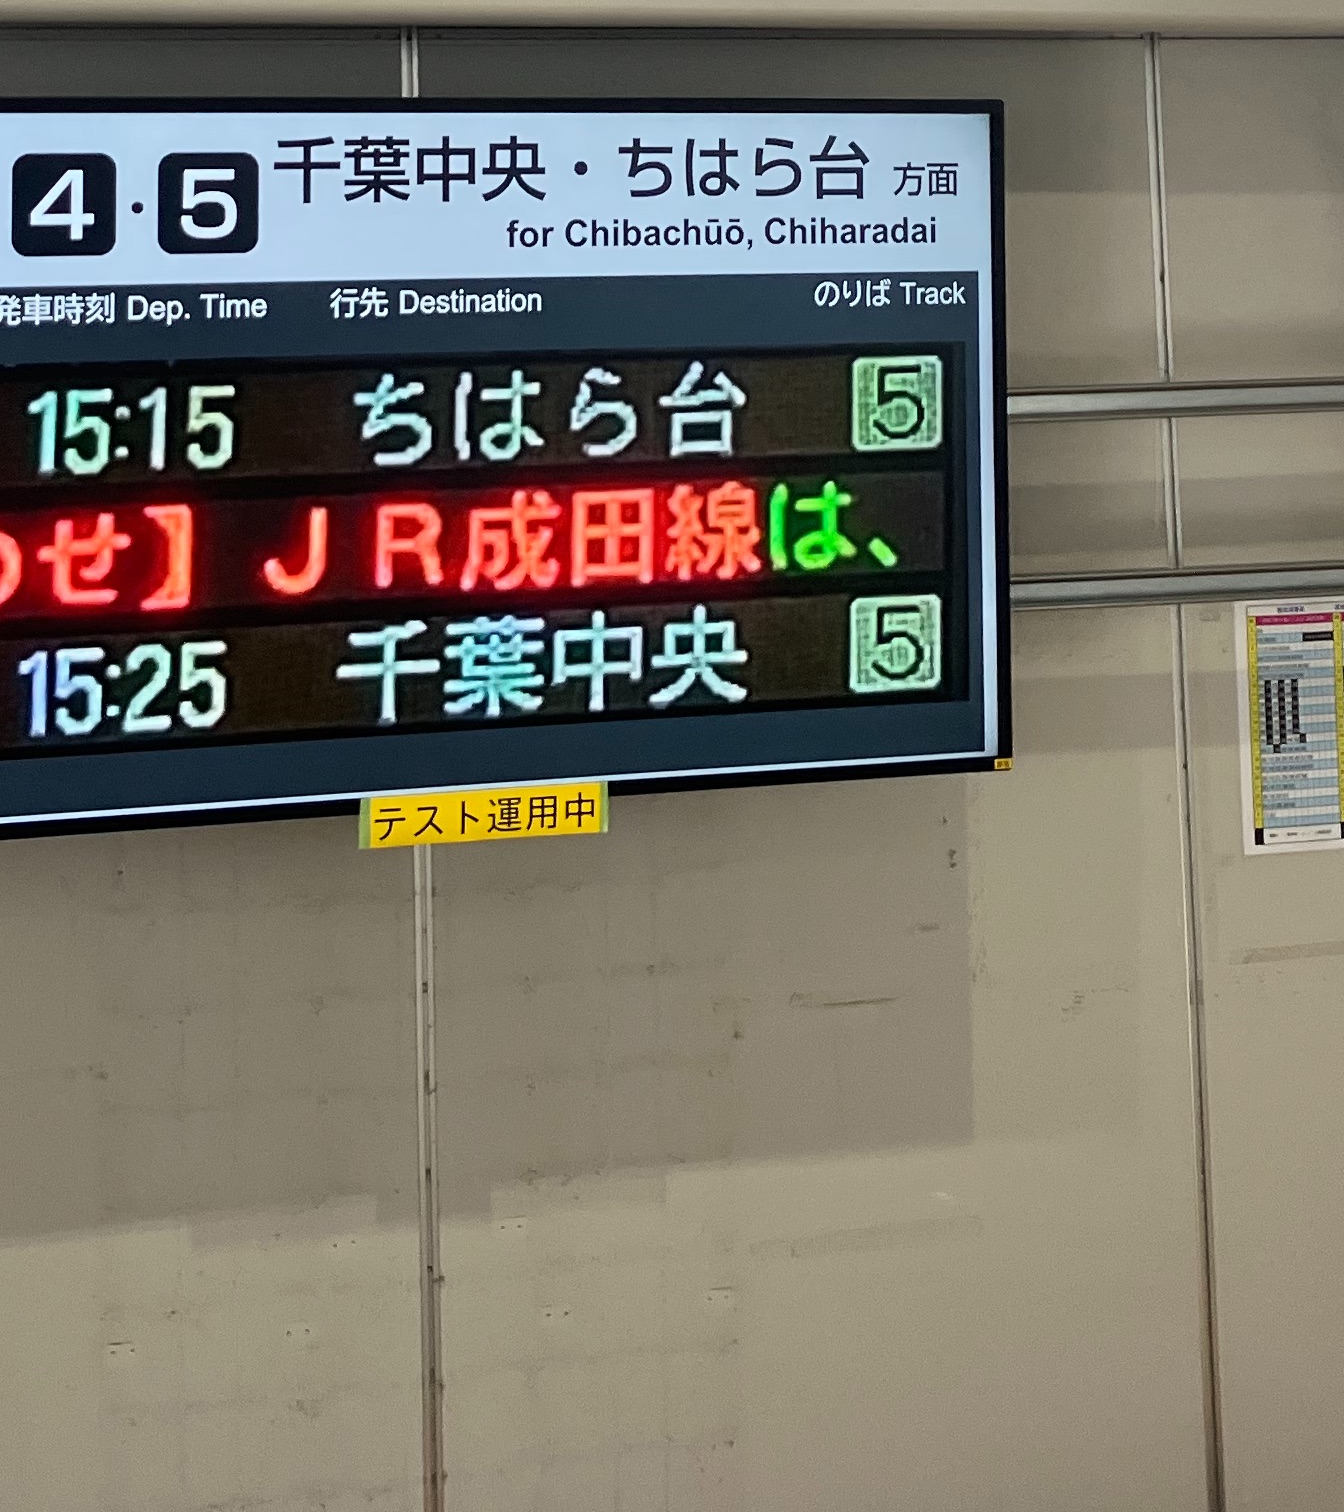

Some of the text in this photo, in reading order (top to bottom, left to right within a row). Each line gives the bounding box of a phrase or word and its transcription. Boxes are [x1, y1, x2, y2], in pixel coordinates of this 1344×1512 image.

[273, 134, 959, 204] 千葉中央・ちはら台 方面
[29, 169, 95, 240] 4
[180, 168, 237, 239] 5
[506, 214, 937, 250] for Chibachūō, Chiharadai
[127, 295, 190, 325] Dep.
[200, 293, 268, 319] Time
[329, 288, 543, 319] 行先 Destination
[813, 280, 966, 308] のりば Track
[27, 383, 236, 477] 15:15
[353, 361, 749, 467] ちはら台
[19, 640, 228, 740] 15:25
[335, 604, 748, 729] 千葉中央
[374, 791, 595, 841] テスト運用中
